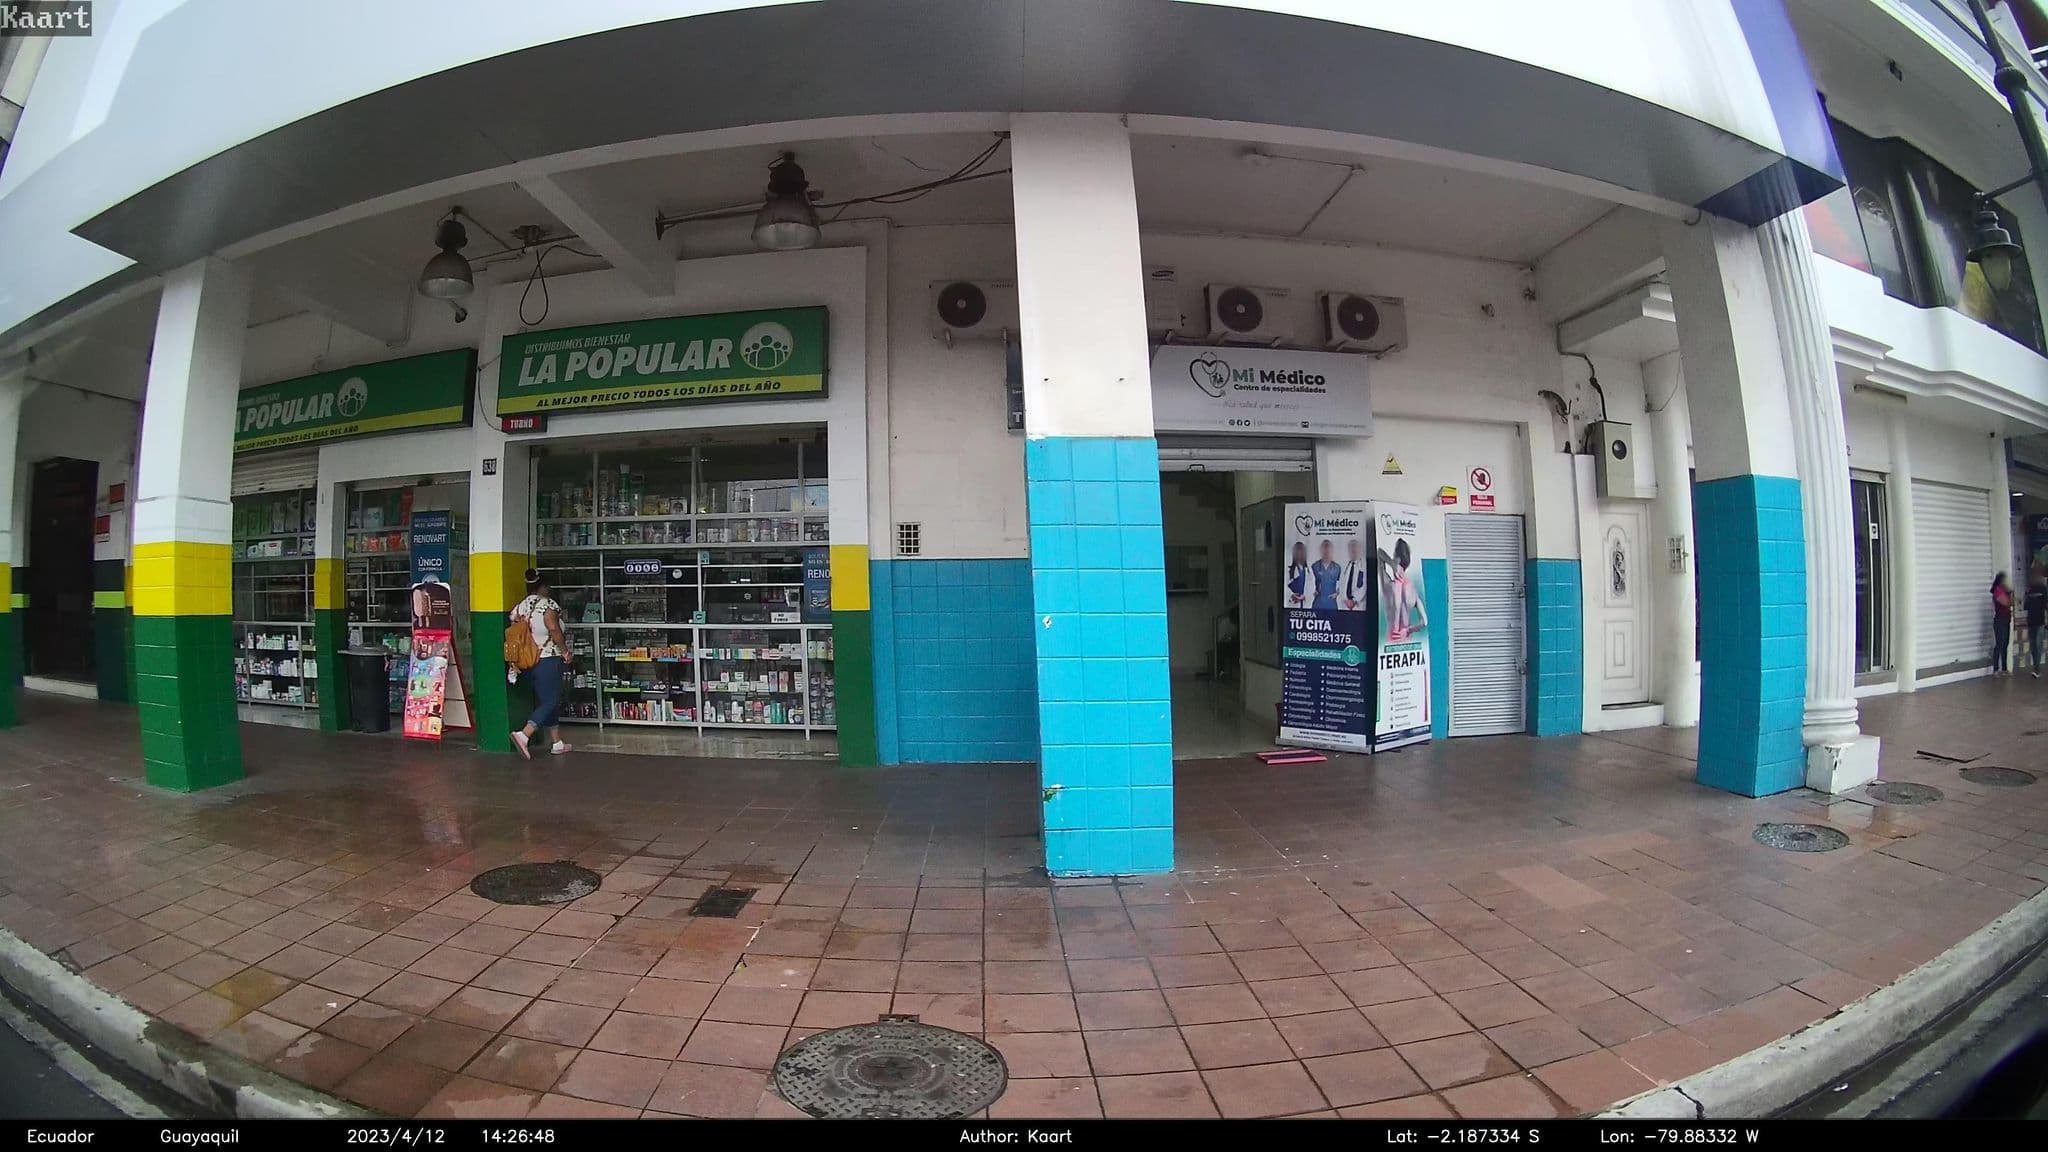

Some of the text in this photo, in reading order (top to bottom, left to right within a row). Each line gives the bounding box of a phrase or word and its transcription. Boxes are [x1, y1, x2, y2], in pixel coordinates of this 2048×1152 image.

[525, 333, 631, 355] DISTRIBUIMOS BIENESTAR
[518, 338, 733, 387] LA POPULAR
[1232, 367, 1326, 386] Mi Médico
[536, 380, 781, 408] AL MEJOR PRECIO TODOS LOS DÍAS DEL AÑO
[1233, 383, 1326, 394] Centro de especialidades
[243, 392, 335, 432] POPULAR
[1314, 518, 1359, 528] Mi Médico
[413, 533, 447, 544] RENOVART
[418, 556, 442, 567] ÚNICO
[1289, 618, 1332, 631] TU CITA
[1296, 632, 1352, 644] 0998521375
[1288, 648, 1342, 659] Especialidades
